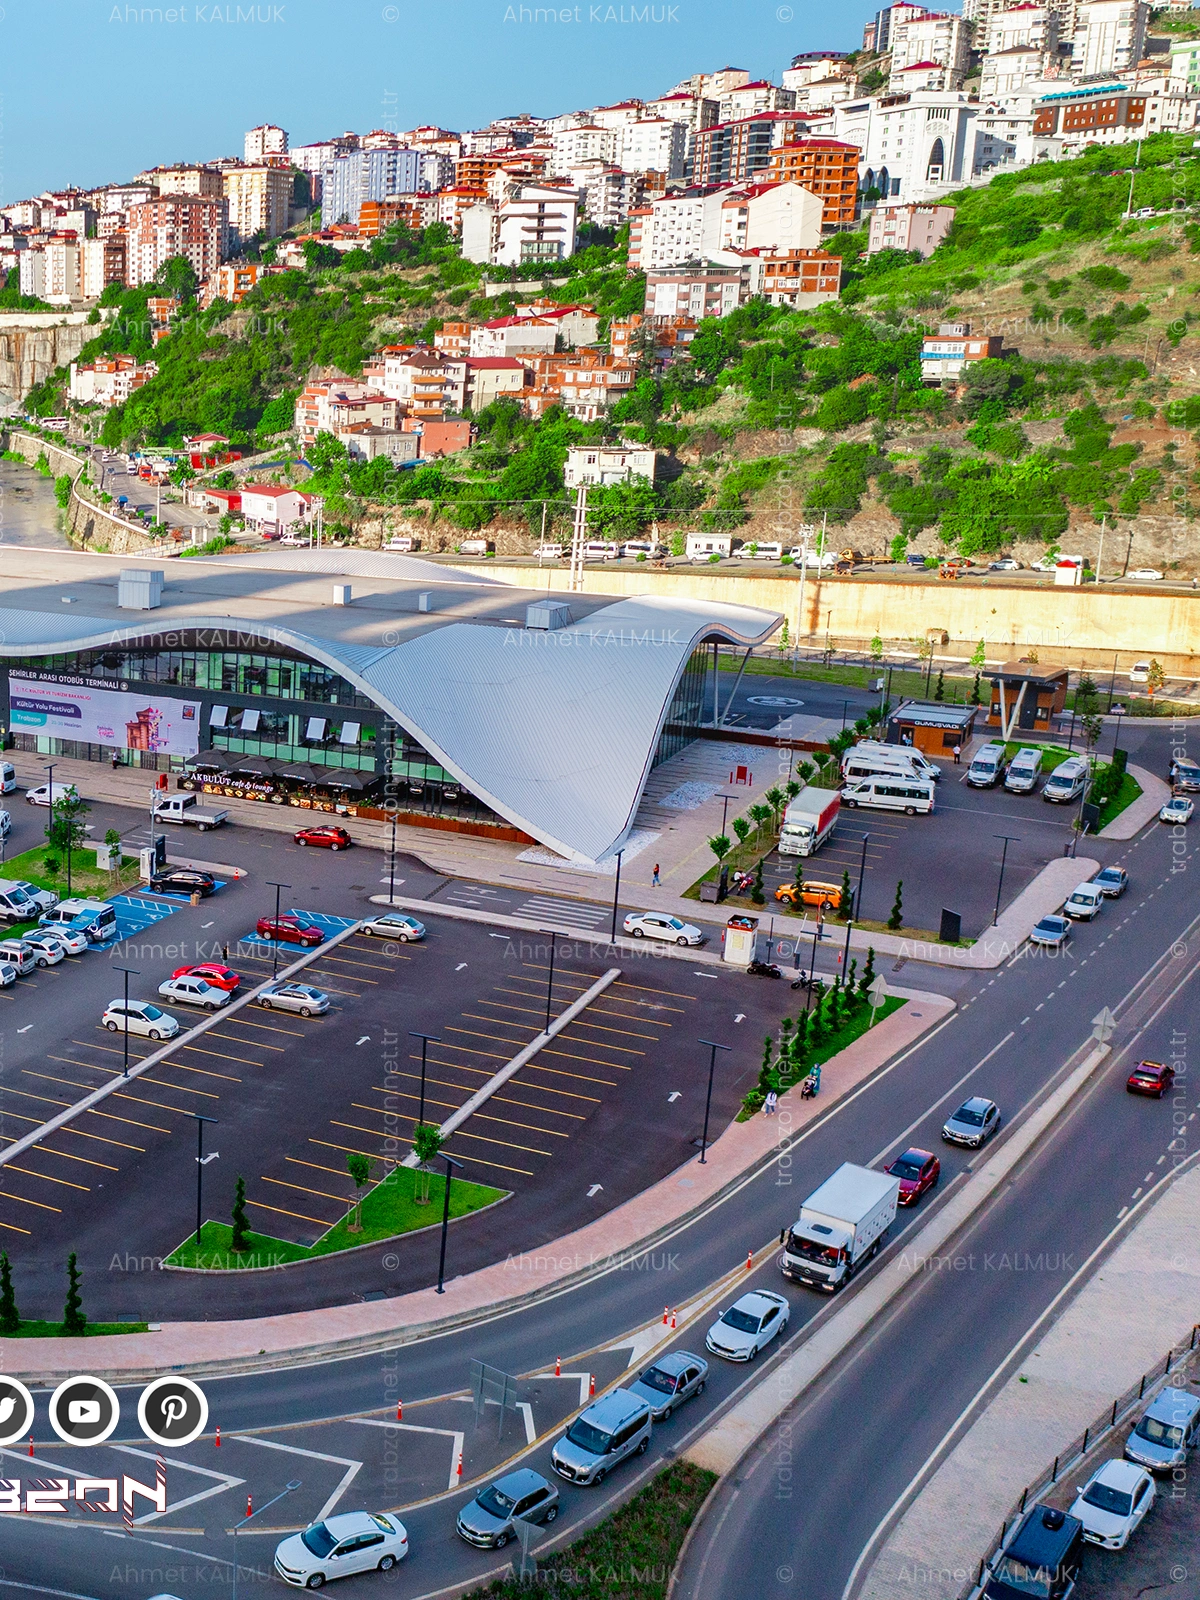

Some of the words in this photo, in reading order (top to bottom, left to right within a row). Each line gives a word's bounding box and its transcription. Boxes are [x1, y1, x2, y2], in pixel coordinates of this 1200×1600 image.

[8, 668, 37, 679] ŞEHİRLER
[38, 671, 58, 682] ARASI
[58, 675, 84, 685] OTOBÜS
[85, 678, 119, 690] TERMİNALİ
[16, 700, 34, 709] Kültür
[35, 702, 48, 711] Yolu
[48, 704, 75, 714] Festivali
[17, 714, 41, 723] Trabzon
[190, 773, 232, 785] AKBULUT
[252, 783, 274, 793] lounge
